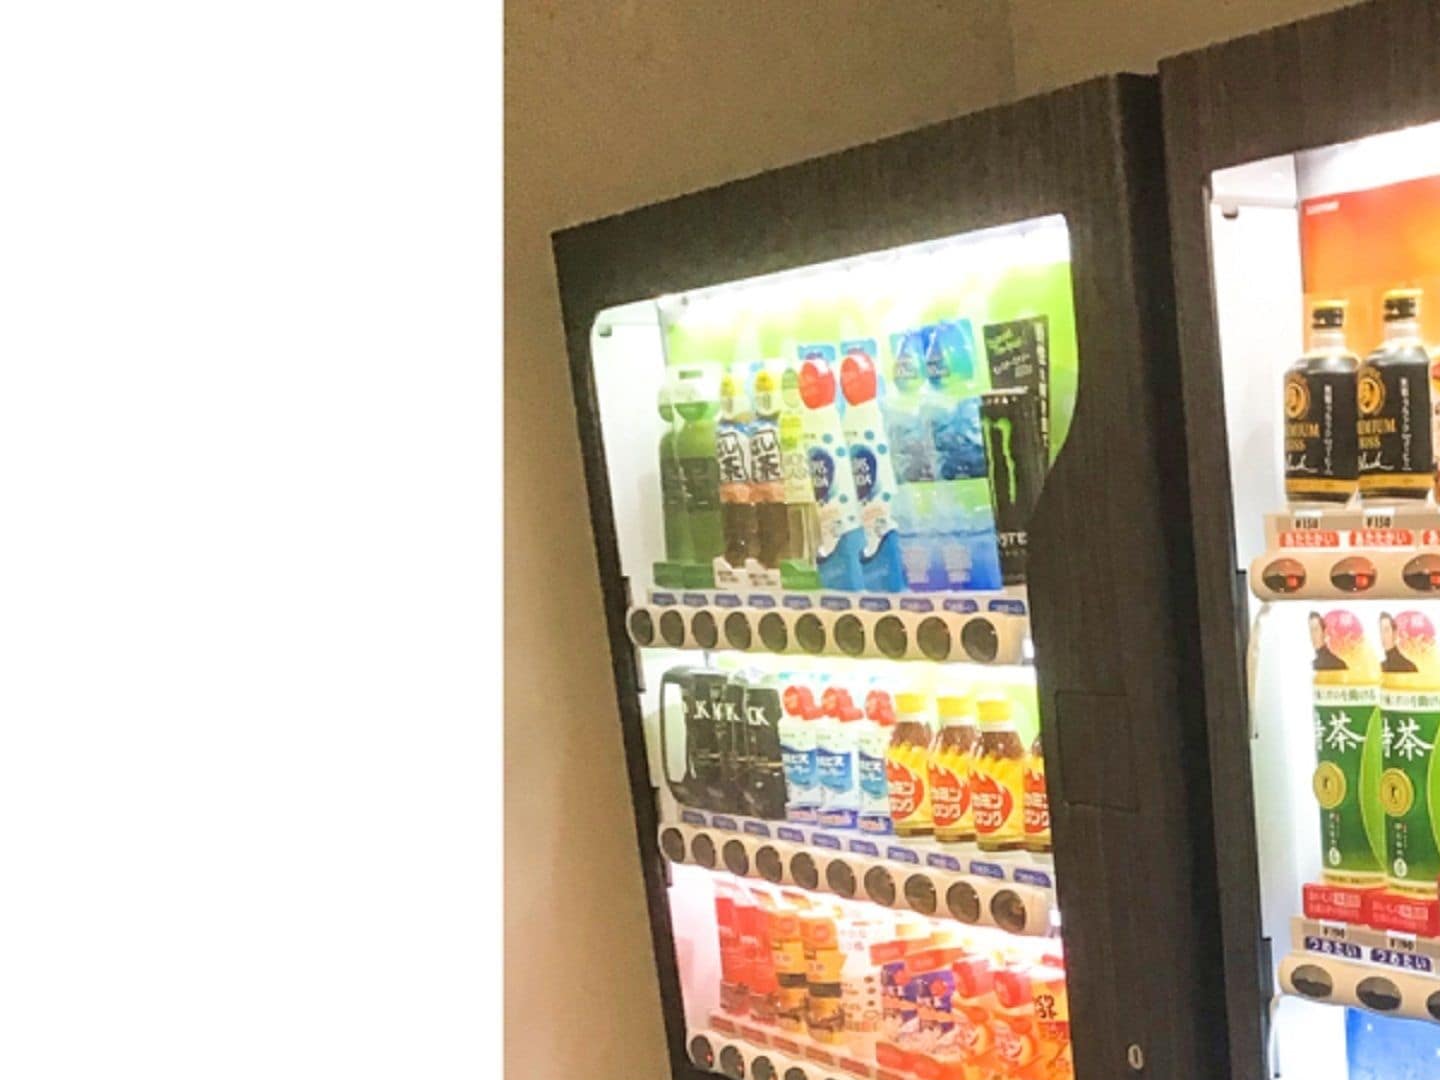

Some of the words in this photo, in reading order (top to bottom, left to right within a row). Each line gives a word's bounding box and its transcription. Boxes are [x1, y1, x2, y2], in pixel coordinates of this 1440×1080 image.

[1310, 937, 1359, 958] つめたい
[1375, 950, 1428, 970] つめたい
